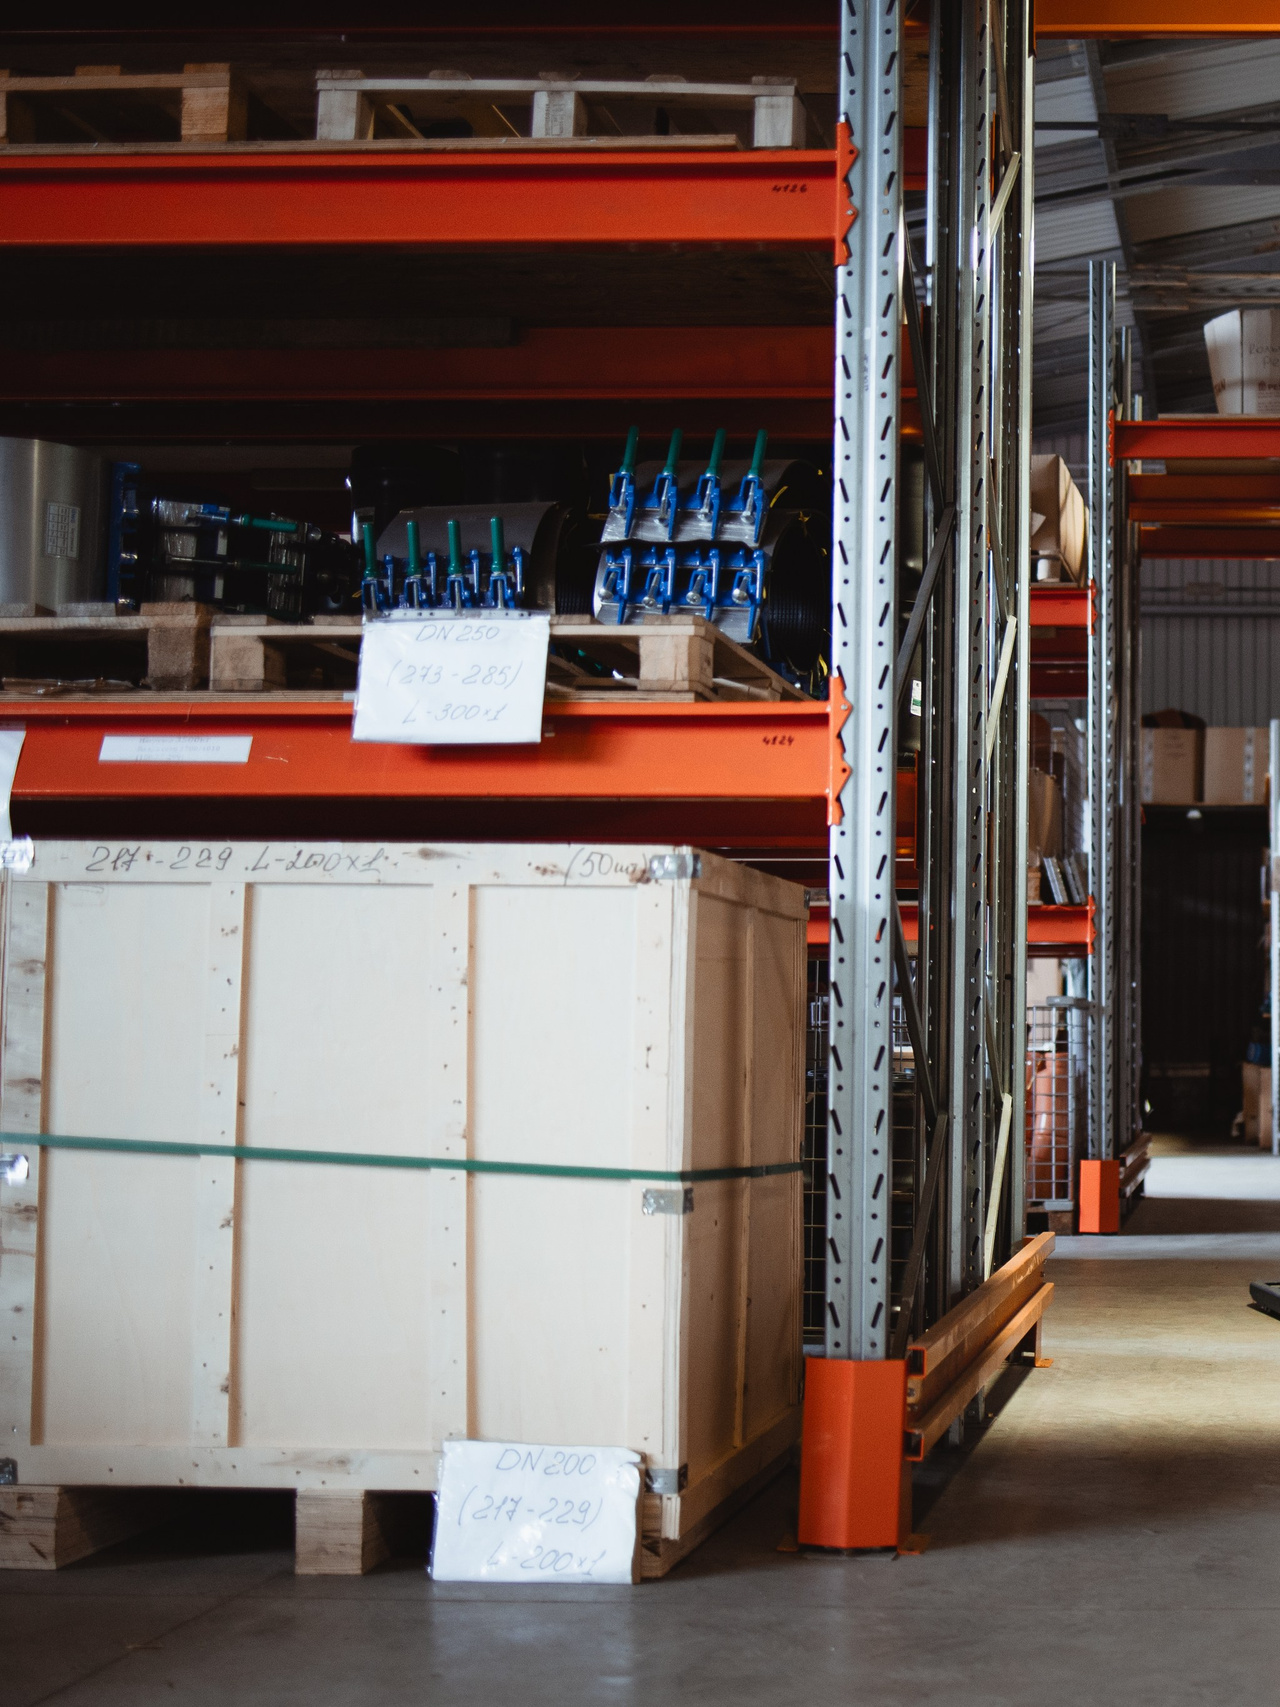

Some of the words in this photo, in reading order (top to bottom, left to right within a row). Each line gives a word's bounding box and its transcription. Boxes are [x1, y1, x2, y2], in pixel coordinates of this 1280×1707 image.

[415, 624, 455, 642] DN
[456, 625, 500, 642] 250
[495, 1448, 545, 1471] DN
[543, 1451, 597, 1476] 200
